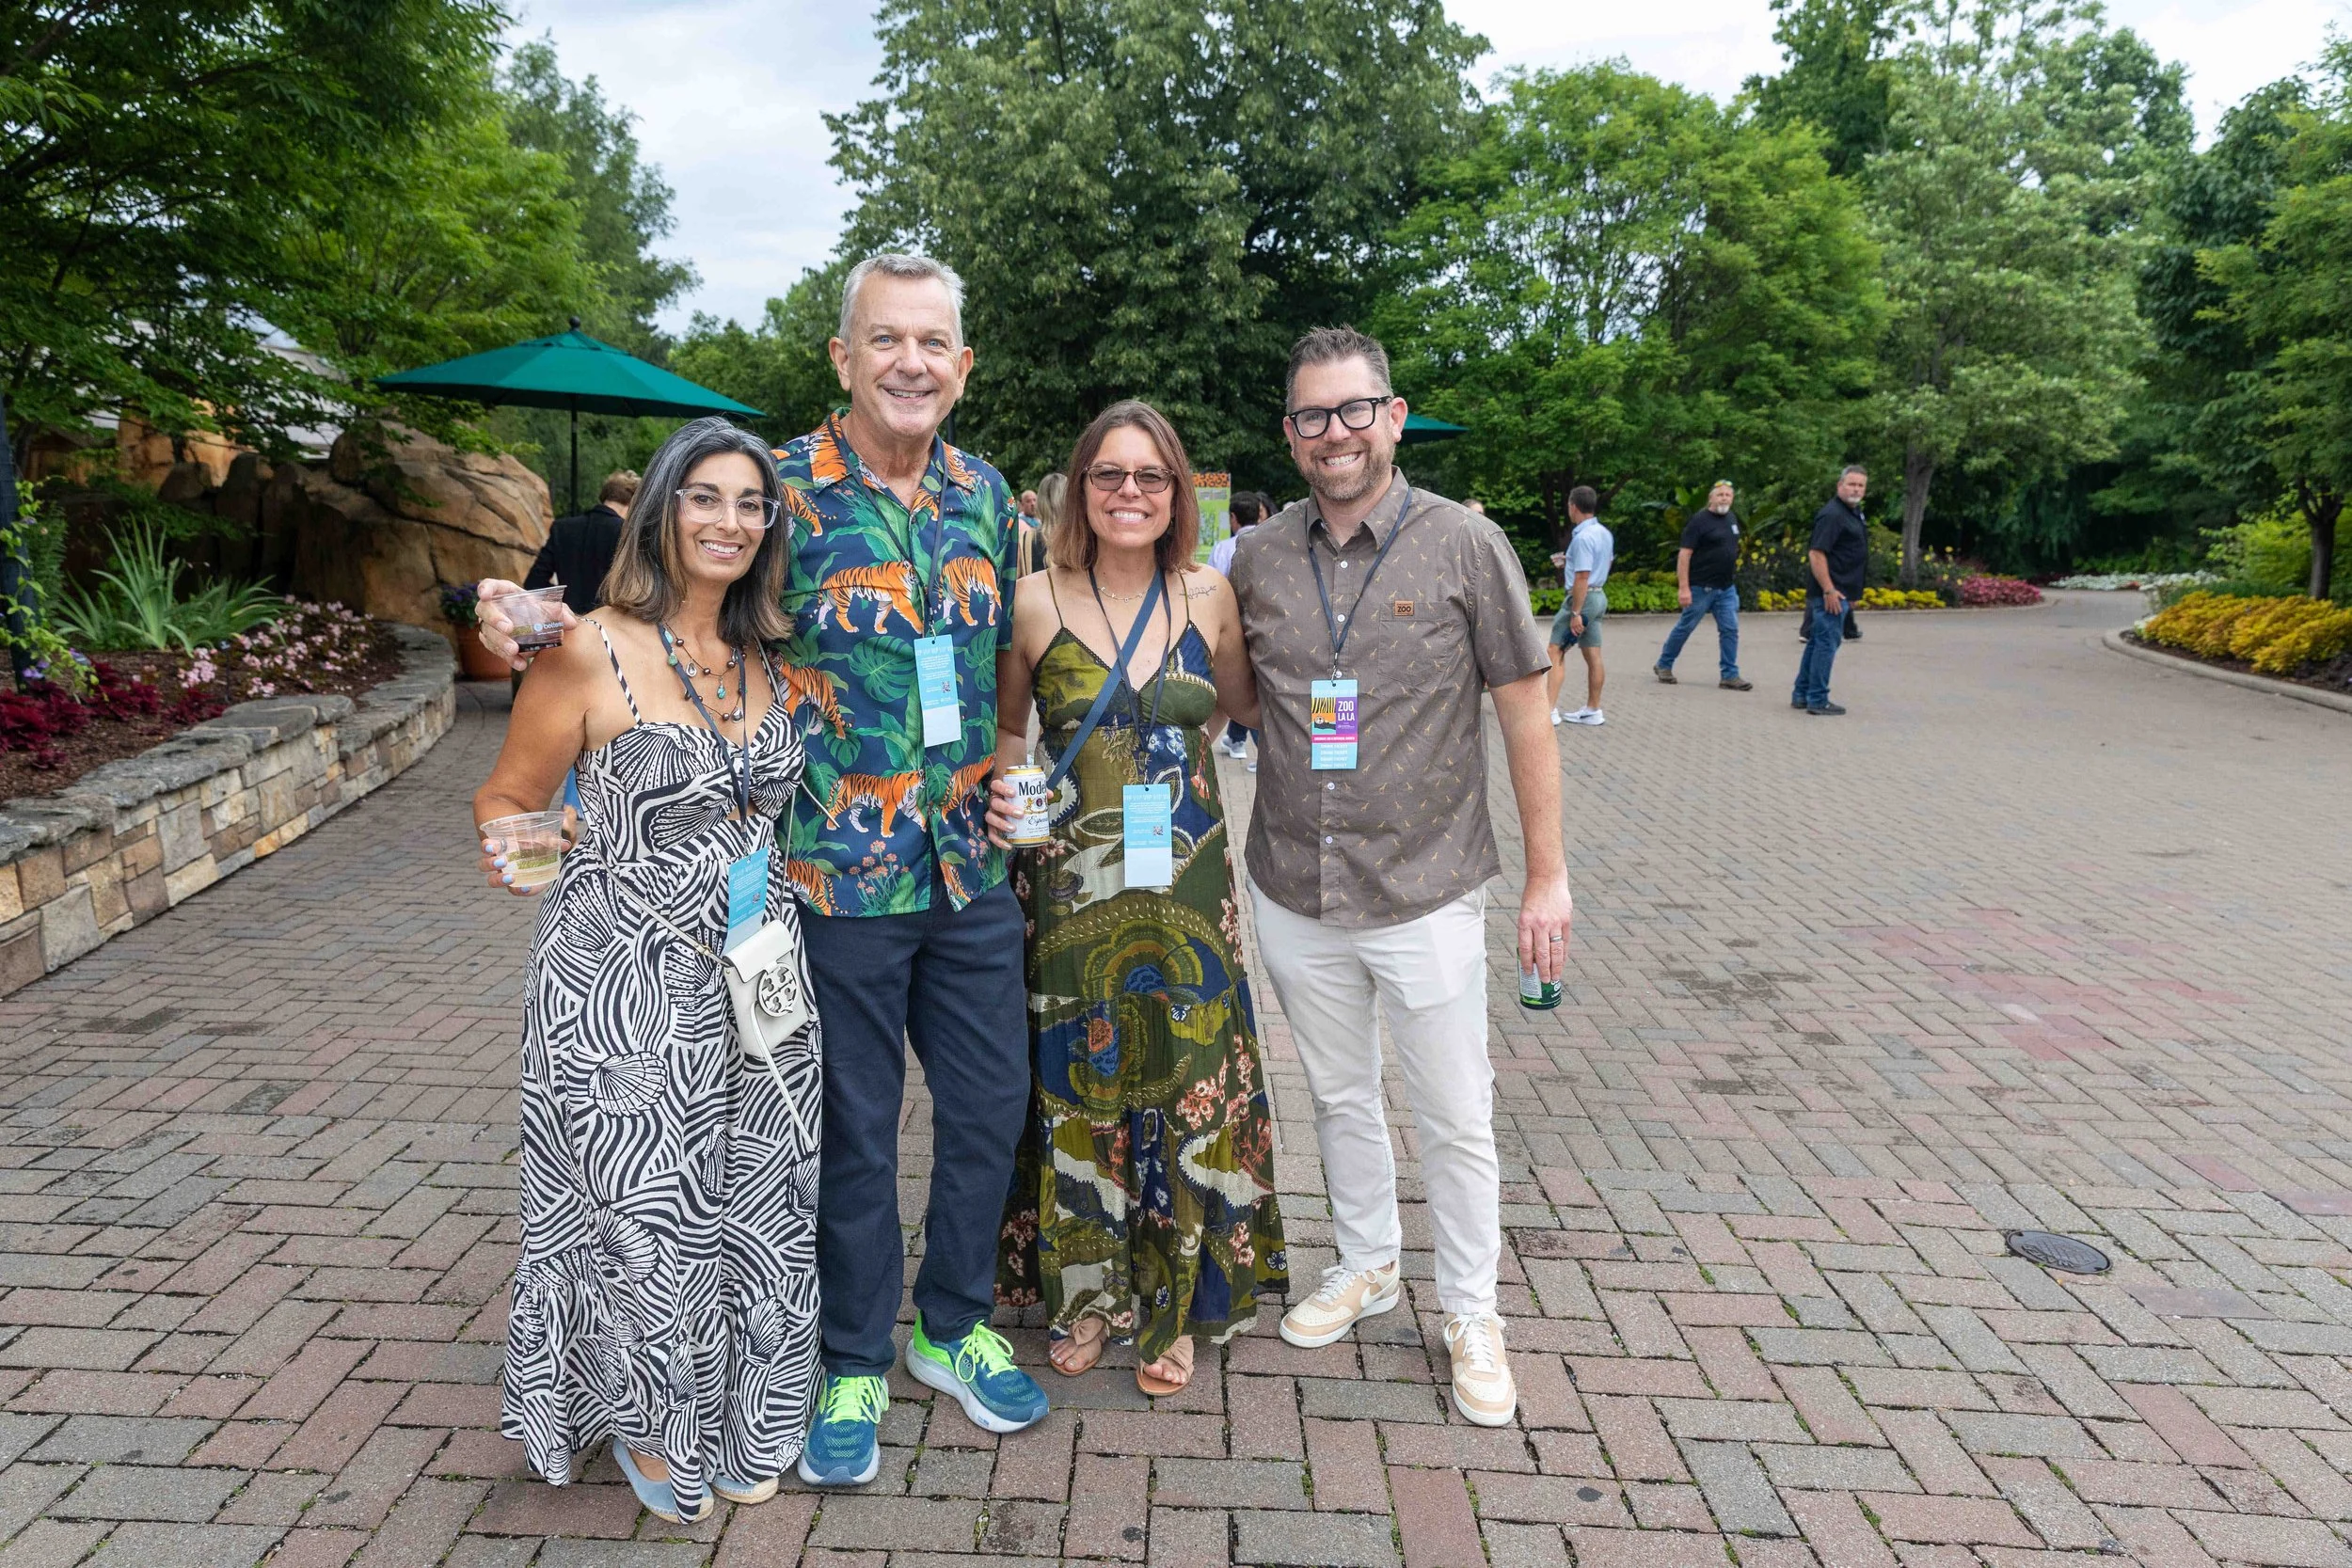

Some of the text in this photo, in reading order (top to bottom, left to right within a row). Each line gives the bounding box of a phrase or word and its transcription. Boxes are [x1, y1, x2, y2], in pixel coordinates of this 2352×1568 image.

[1338, 700, 1354, 712] ZOO
[1338, 712, 1355, 721] LA LA
[1018, 781, 1047, 797] Mode
